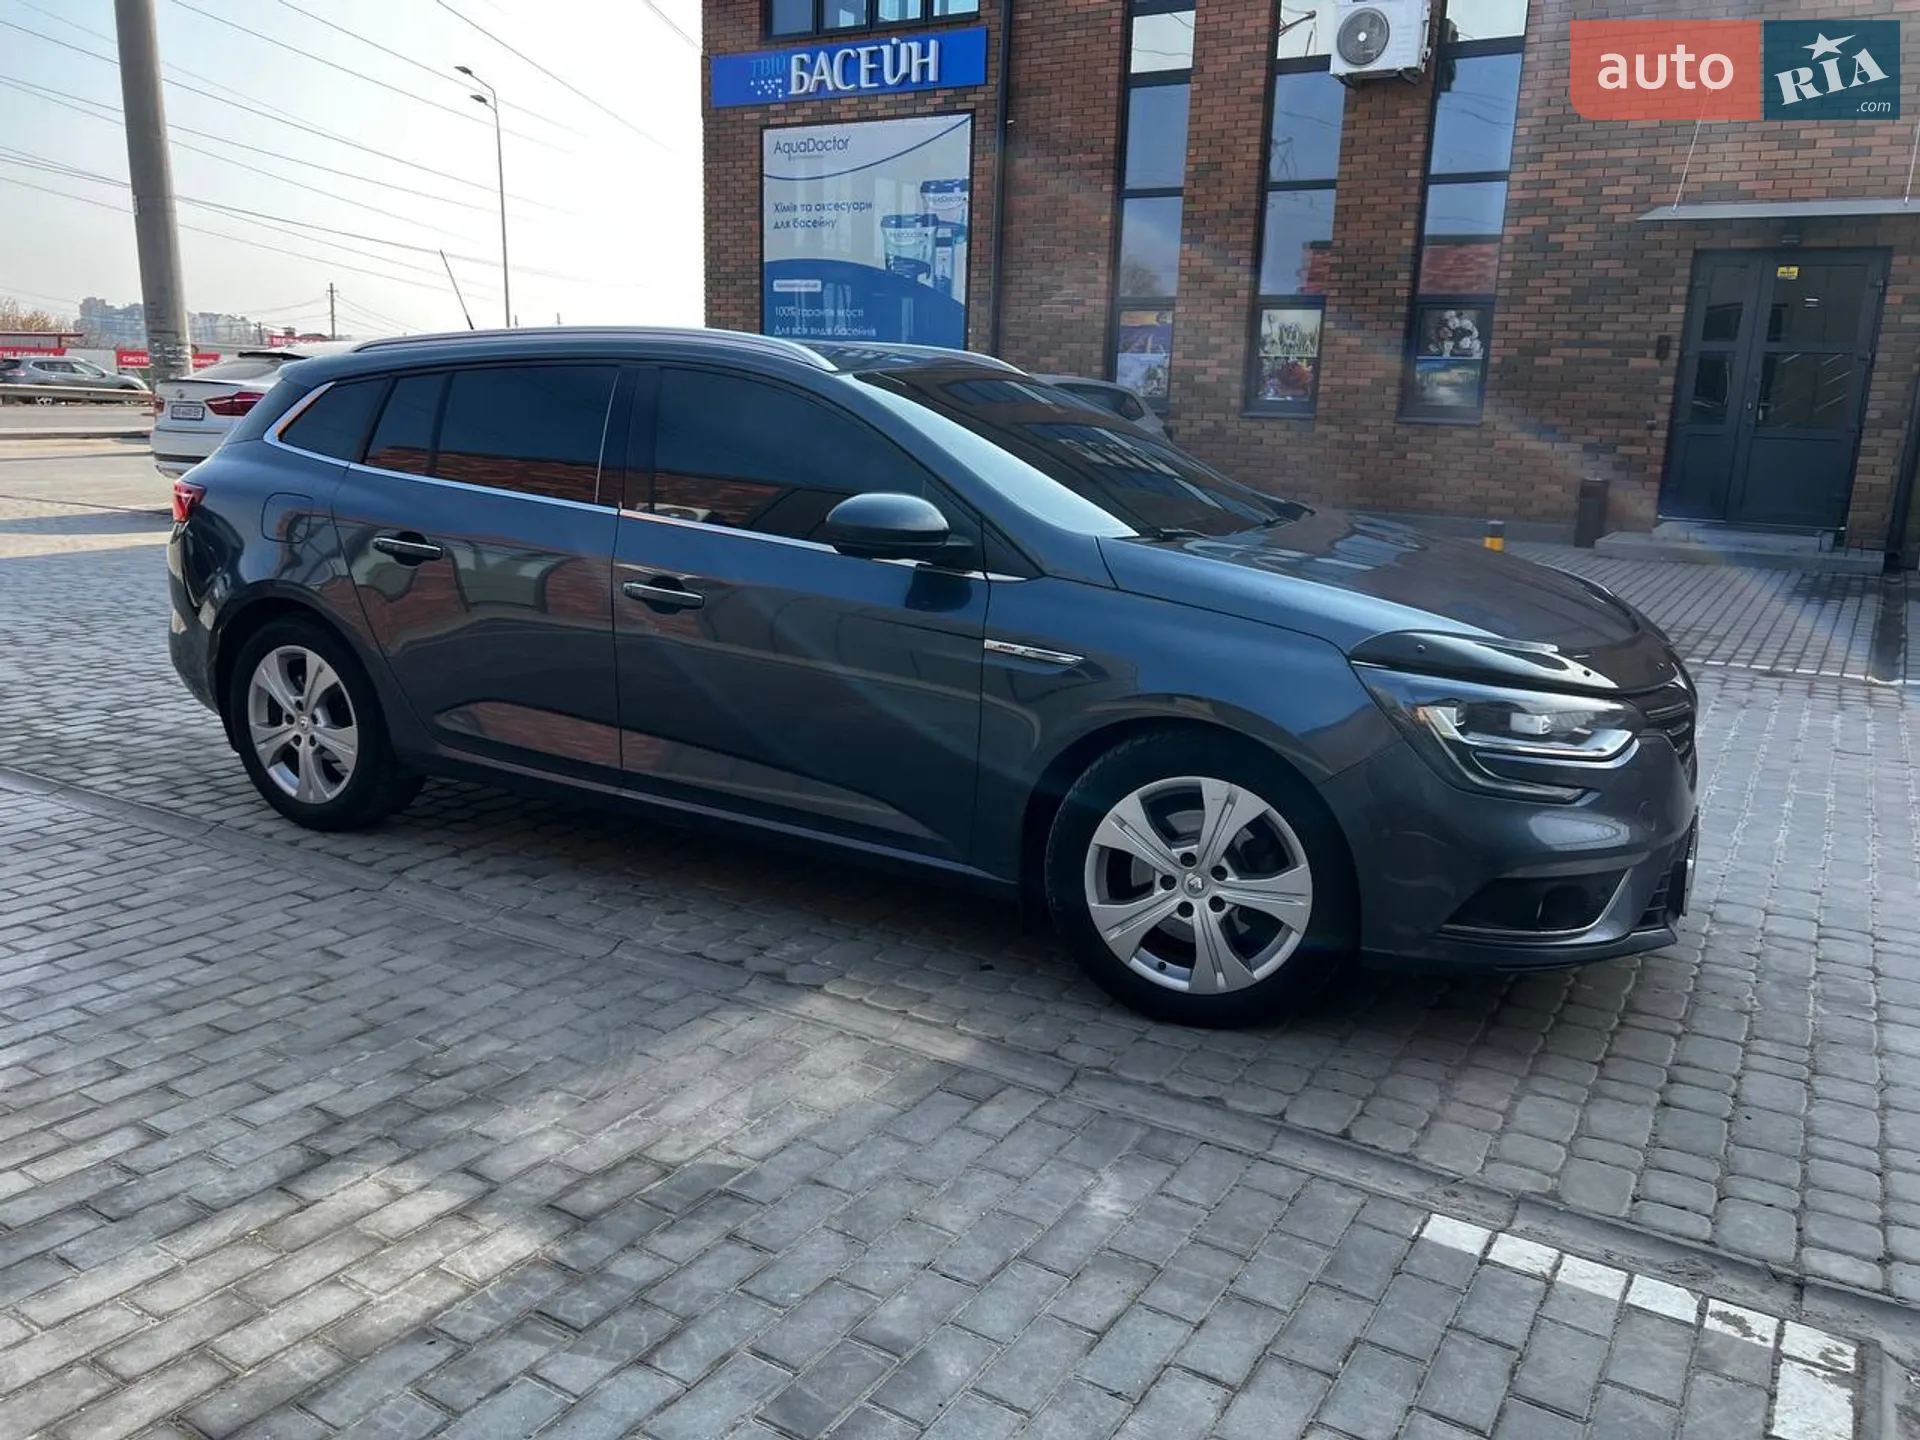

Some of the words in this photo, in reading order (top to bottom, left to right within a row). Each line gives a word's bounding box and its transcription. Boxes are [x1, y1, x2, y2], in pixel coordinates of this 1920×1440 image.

[787, 37, 939, 95] БАСЕЙН
[773, 135, 851, 156] AquaDoctor
[773, 202, 797, 213] Хімія
[800, 204, 812, 212] та
[814, 201, 872, 213] аксесуари
[773, 219, 790, 230] для
[791, 215, 837, 230] басейну
